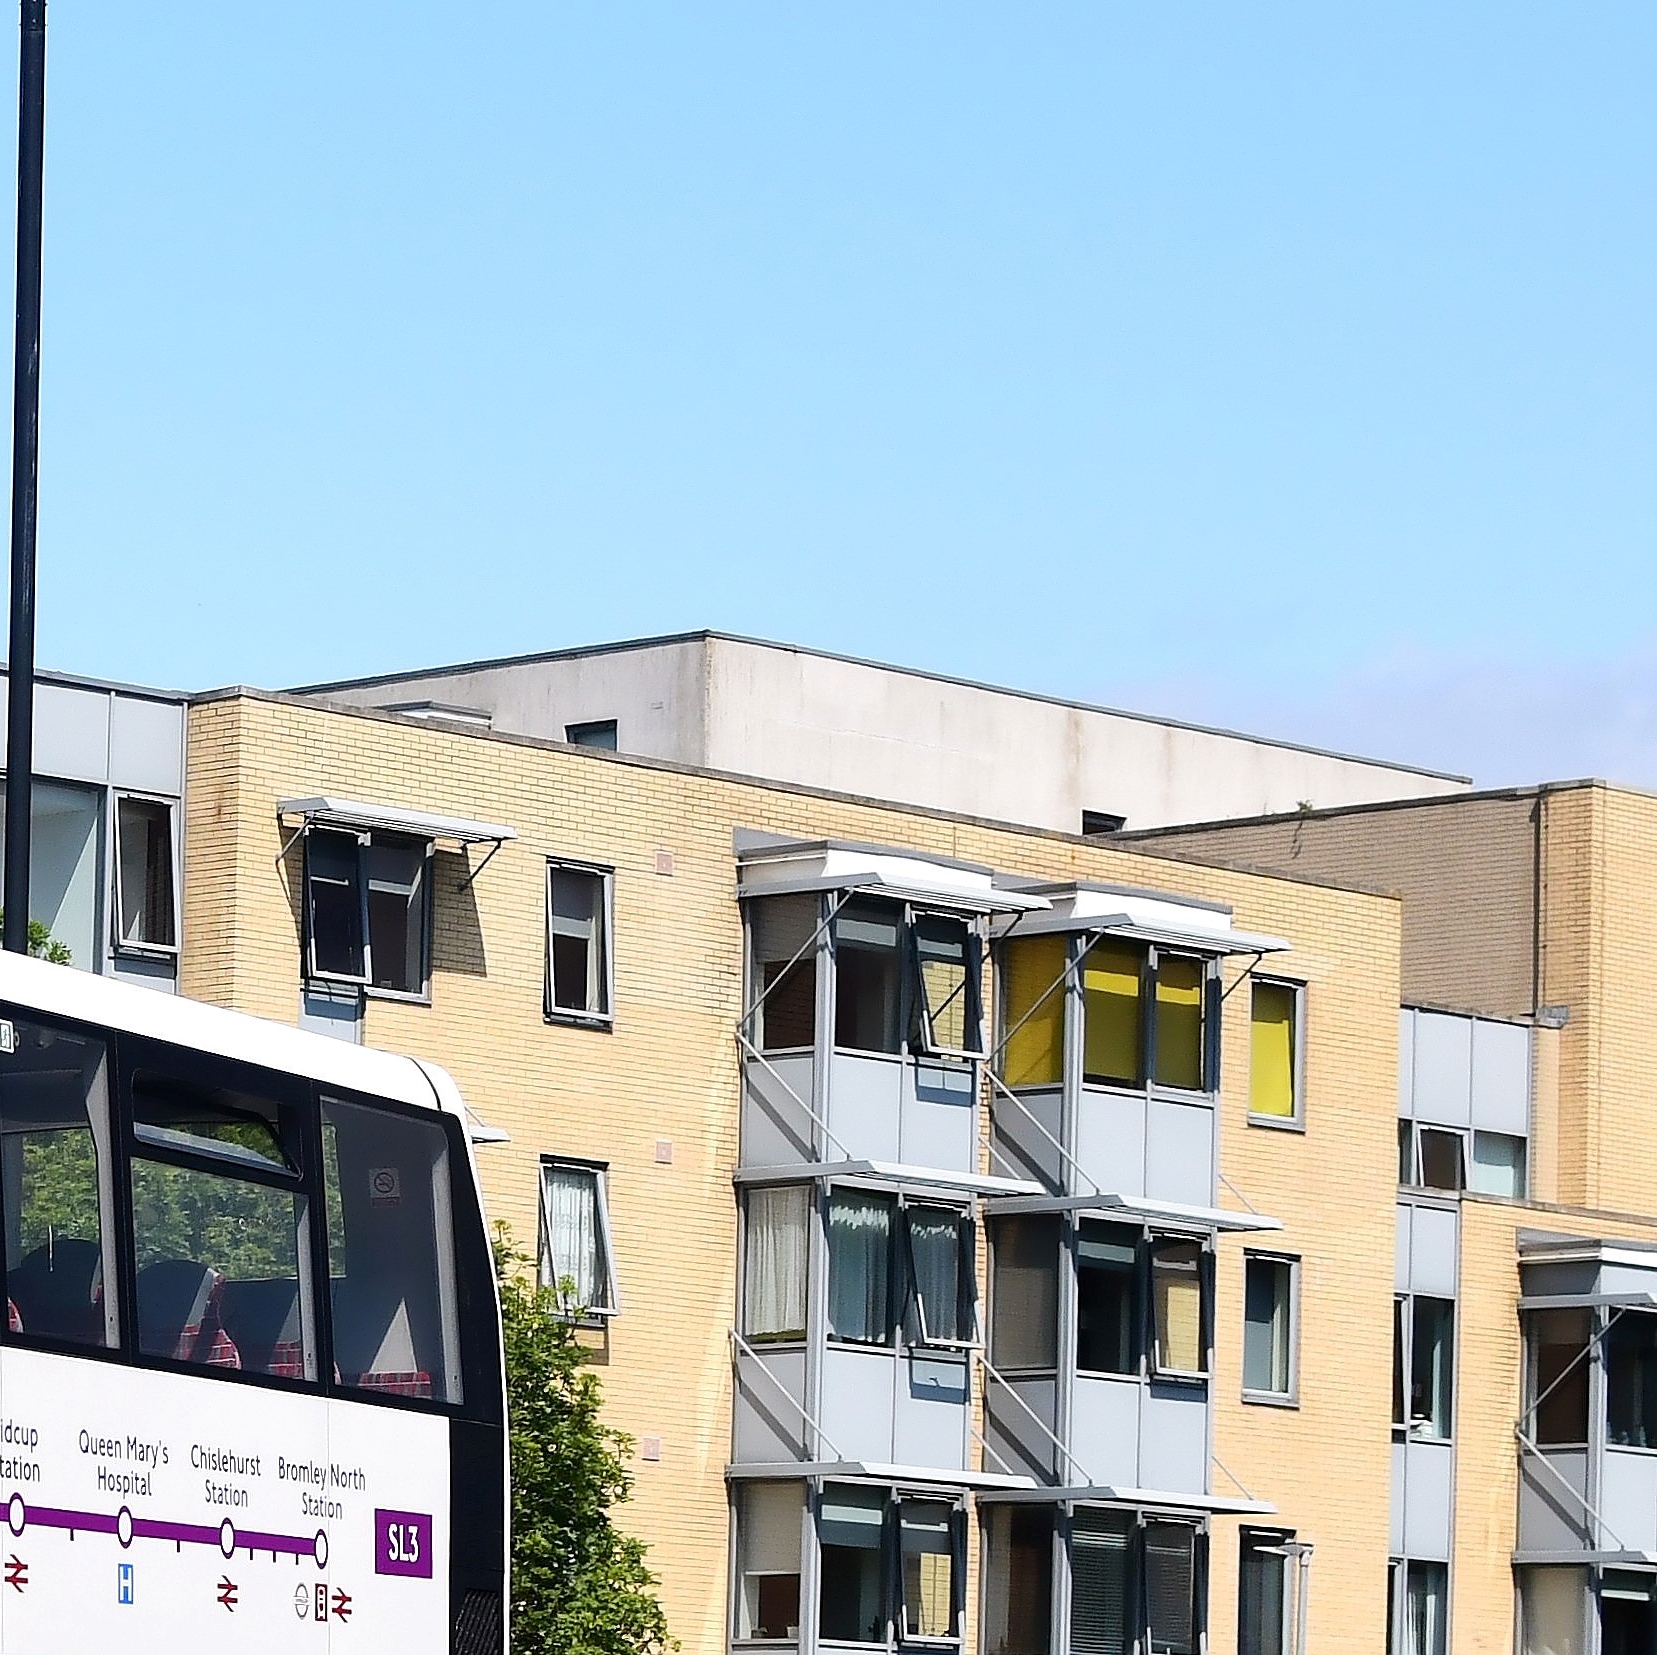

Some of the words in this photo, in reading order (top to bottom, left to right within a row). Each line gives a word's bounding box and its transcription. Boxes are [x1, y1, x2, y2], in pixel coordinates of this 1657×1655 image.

[79, 1429, 122, 1460] Queen
[126, 1432, 169, 1470] Mary's
[190, 1445, 261, 1477] Chislehurst
[97, 1465, 152, 1499] Hospital
[277, 1457, 327, 1485] Bromley
[330, 1463, 366, 1491] North
[205, 1480, 248, 1508] Station
[302, 1492, 343, 1520] Station
[388, 1523, 418, 1563] SL3
